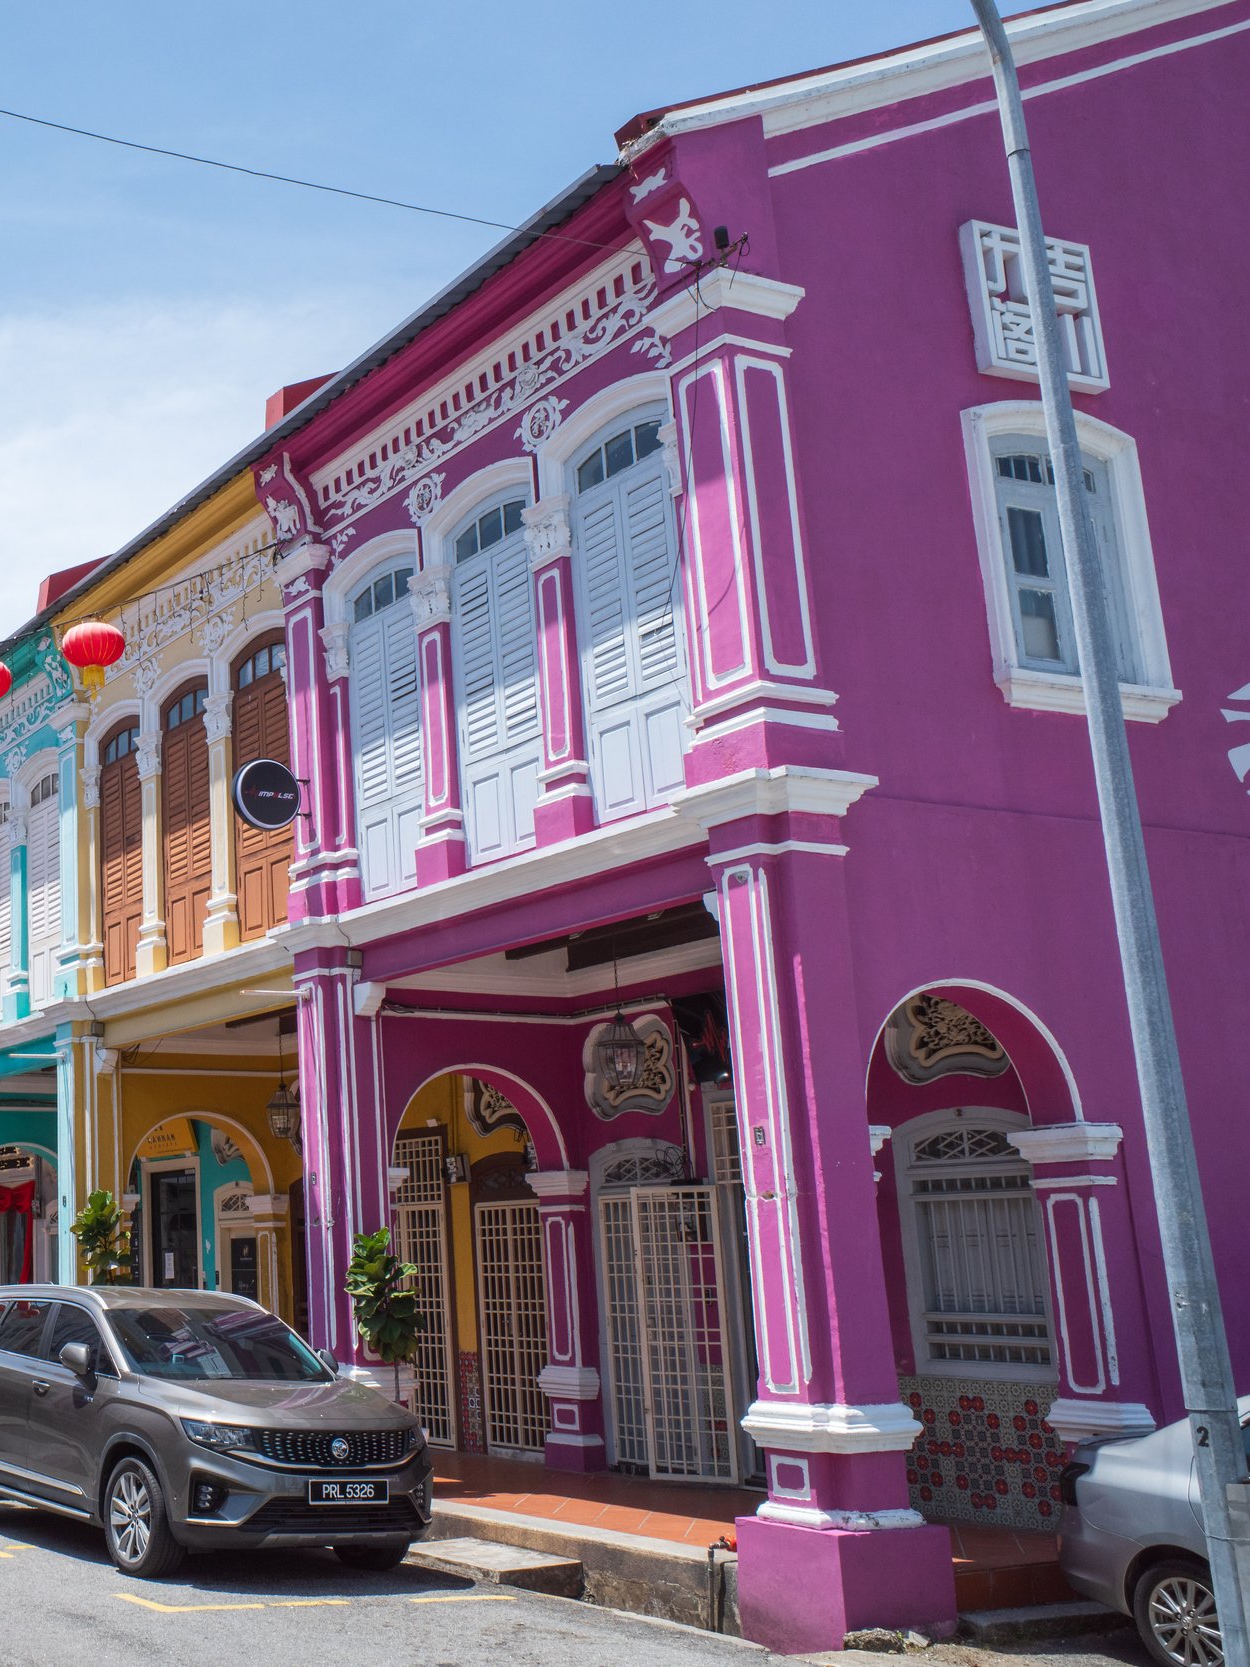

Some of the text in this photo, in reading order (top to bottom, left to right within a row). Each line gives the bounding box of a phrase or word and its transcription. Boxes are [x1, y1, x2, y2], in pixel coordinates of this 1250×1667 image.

[1196, 1426, 1209, 1447] 2
[322, 1484, 374, 1498] PRL 5326
